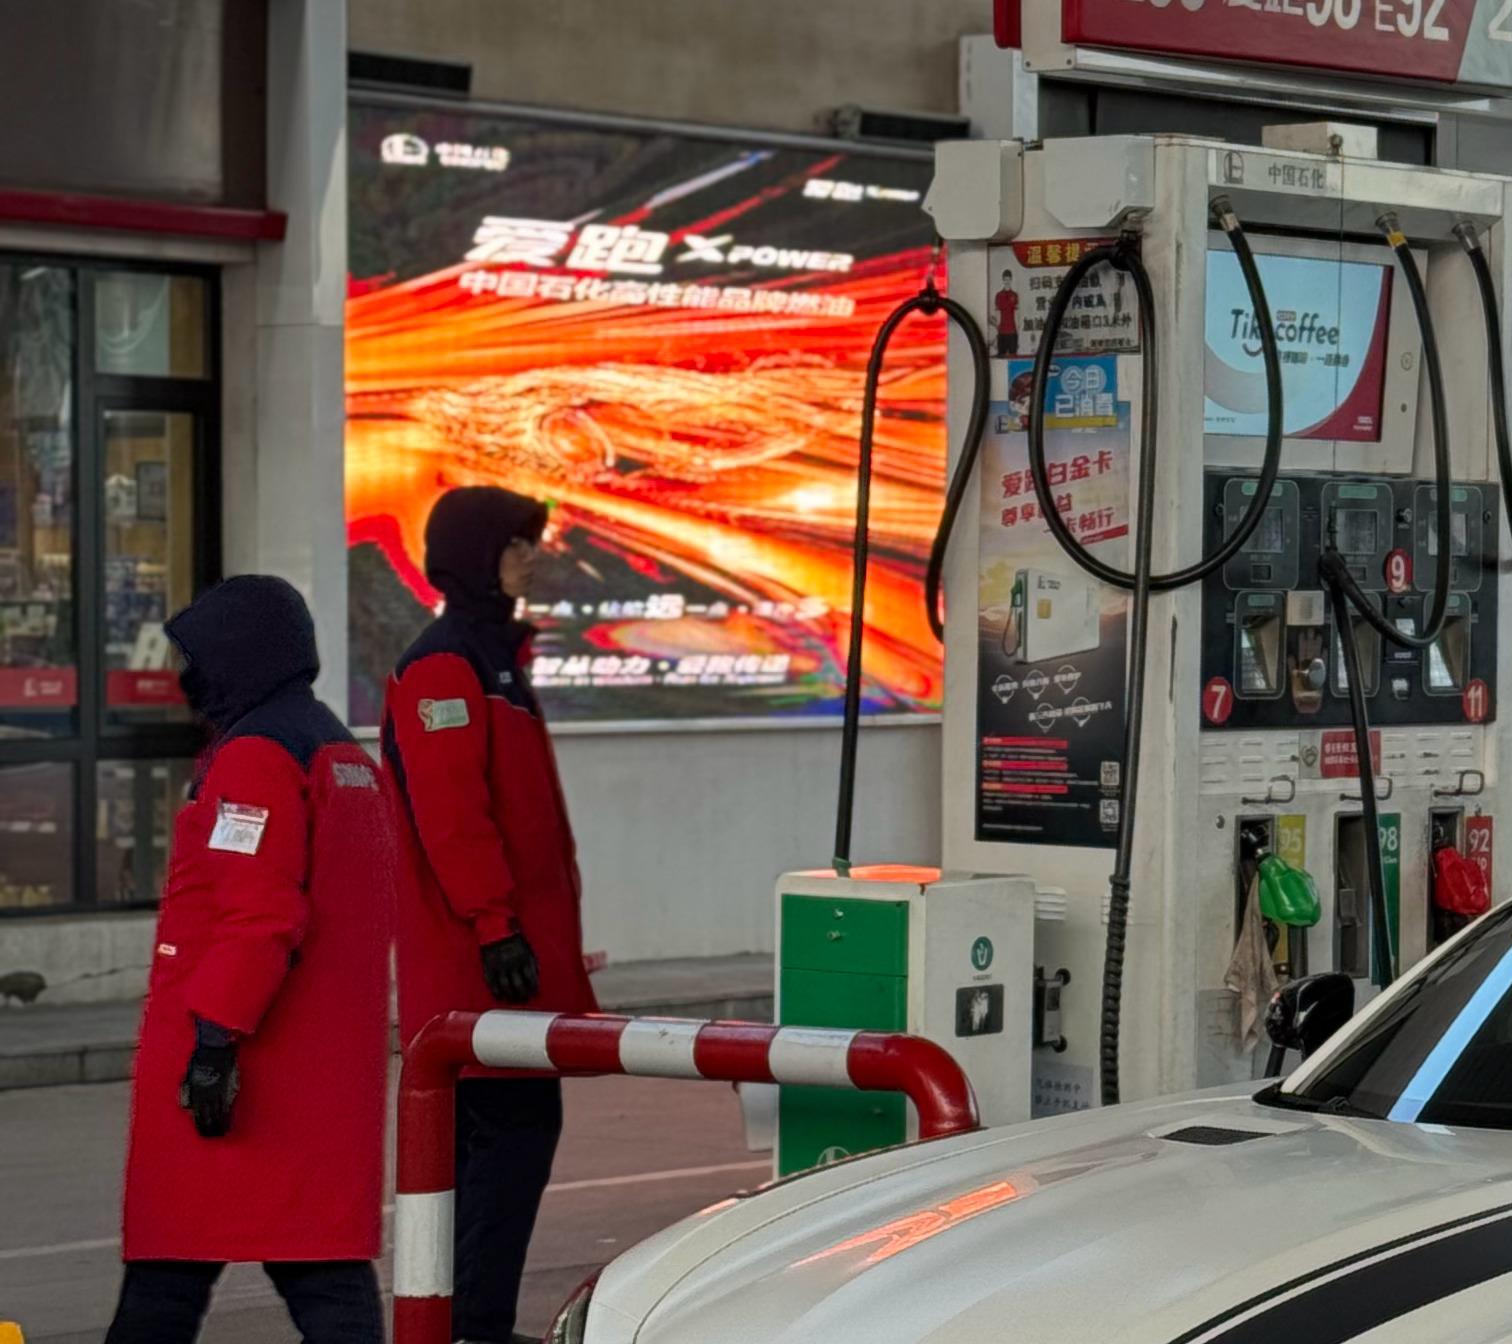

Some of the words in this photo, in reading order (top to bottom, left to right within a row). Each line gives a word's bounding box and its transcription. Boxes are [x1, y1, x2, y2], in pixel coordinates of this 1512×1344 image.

[1268, 162, 1325, 189] 中国石化
[465, 216, 670, 274] 爱跑
[727, 245, 854, 272] POWER
[459, 269, 855, 318] 中国石化高性能品牌燃油
[1002, 493, 1073, 527] 尊享益
[1390, 556, 1405, 591] 9
[1212, 687, 1225, 718] 7
[1468, 688, 1484, 715] 11
[1469, 828, 1490, 853] 92
